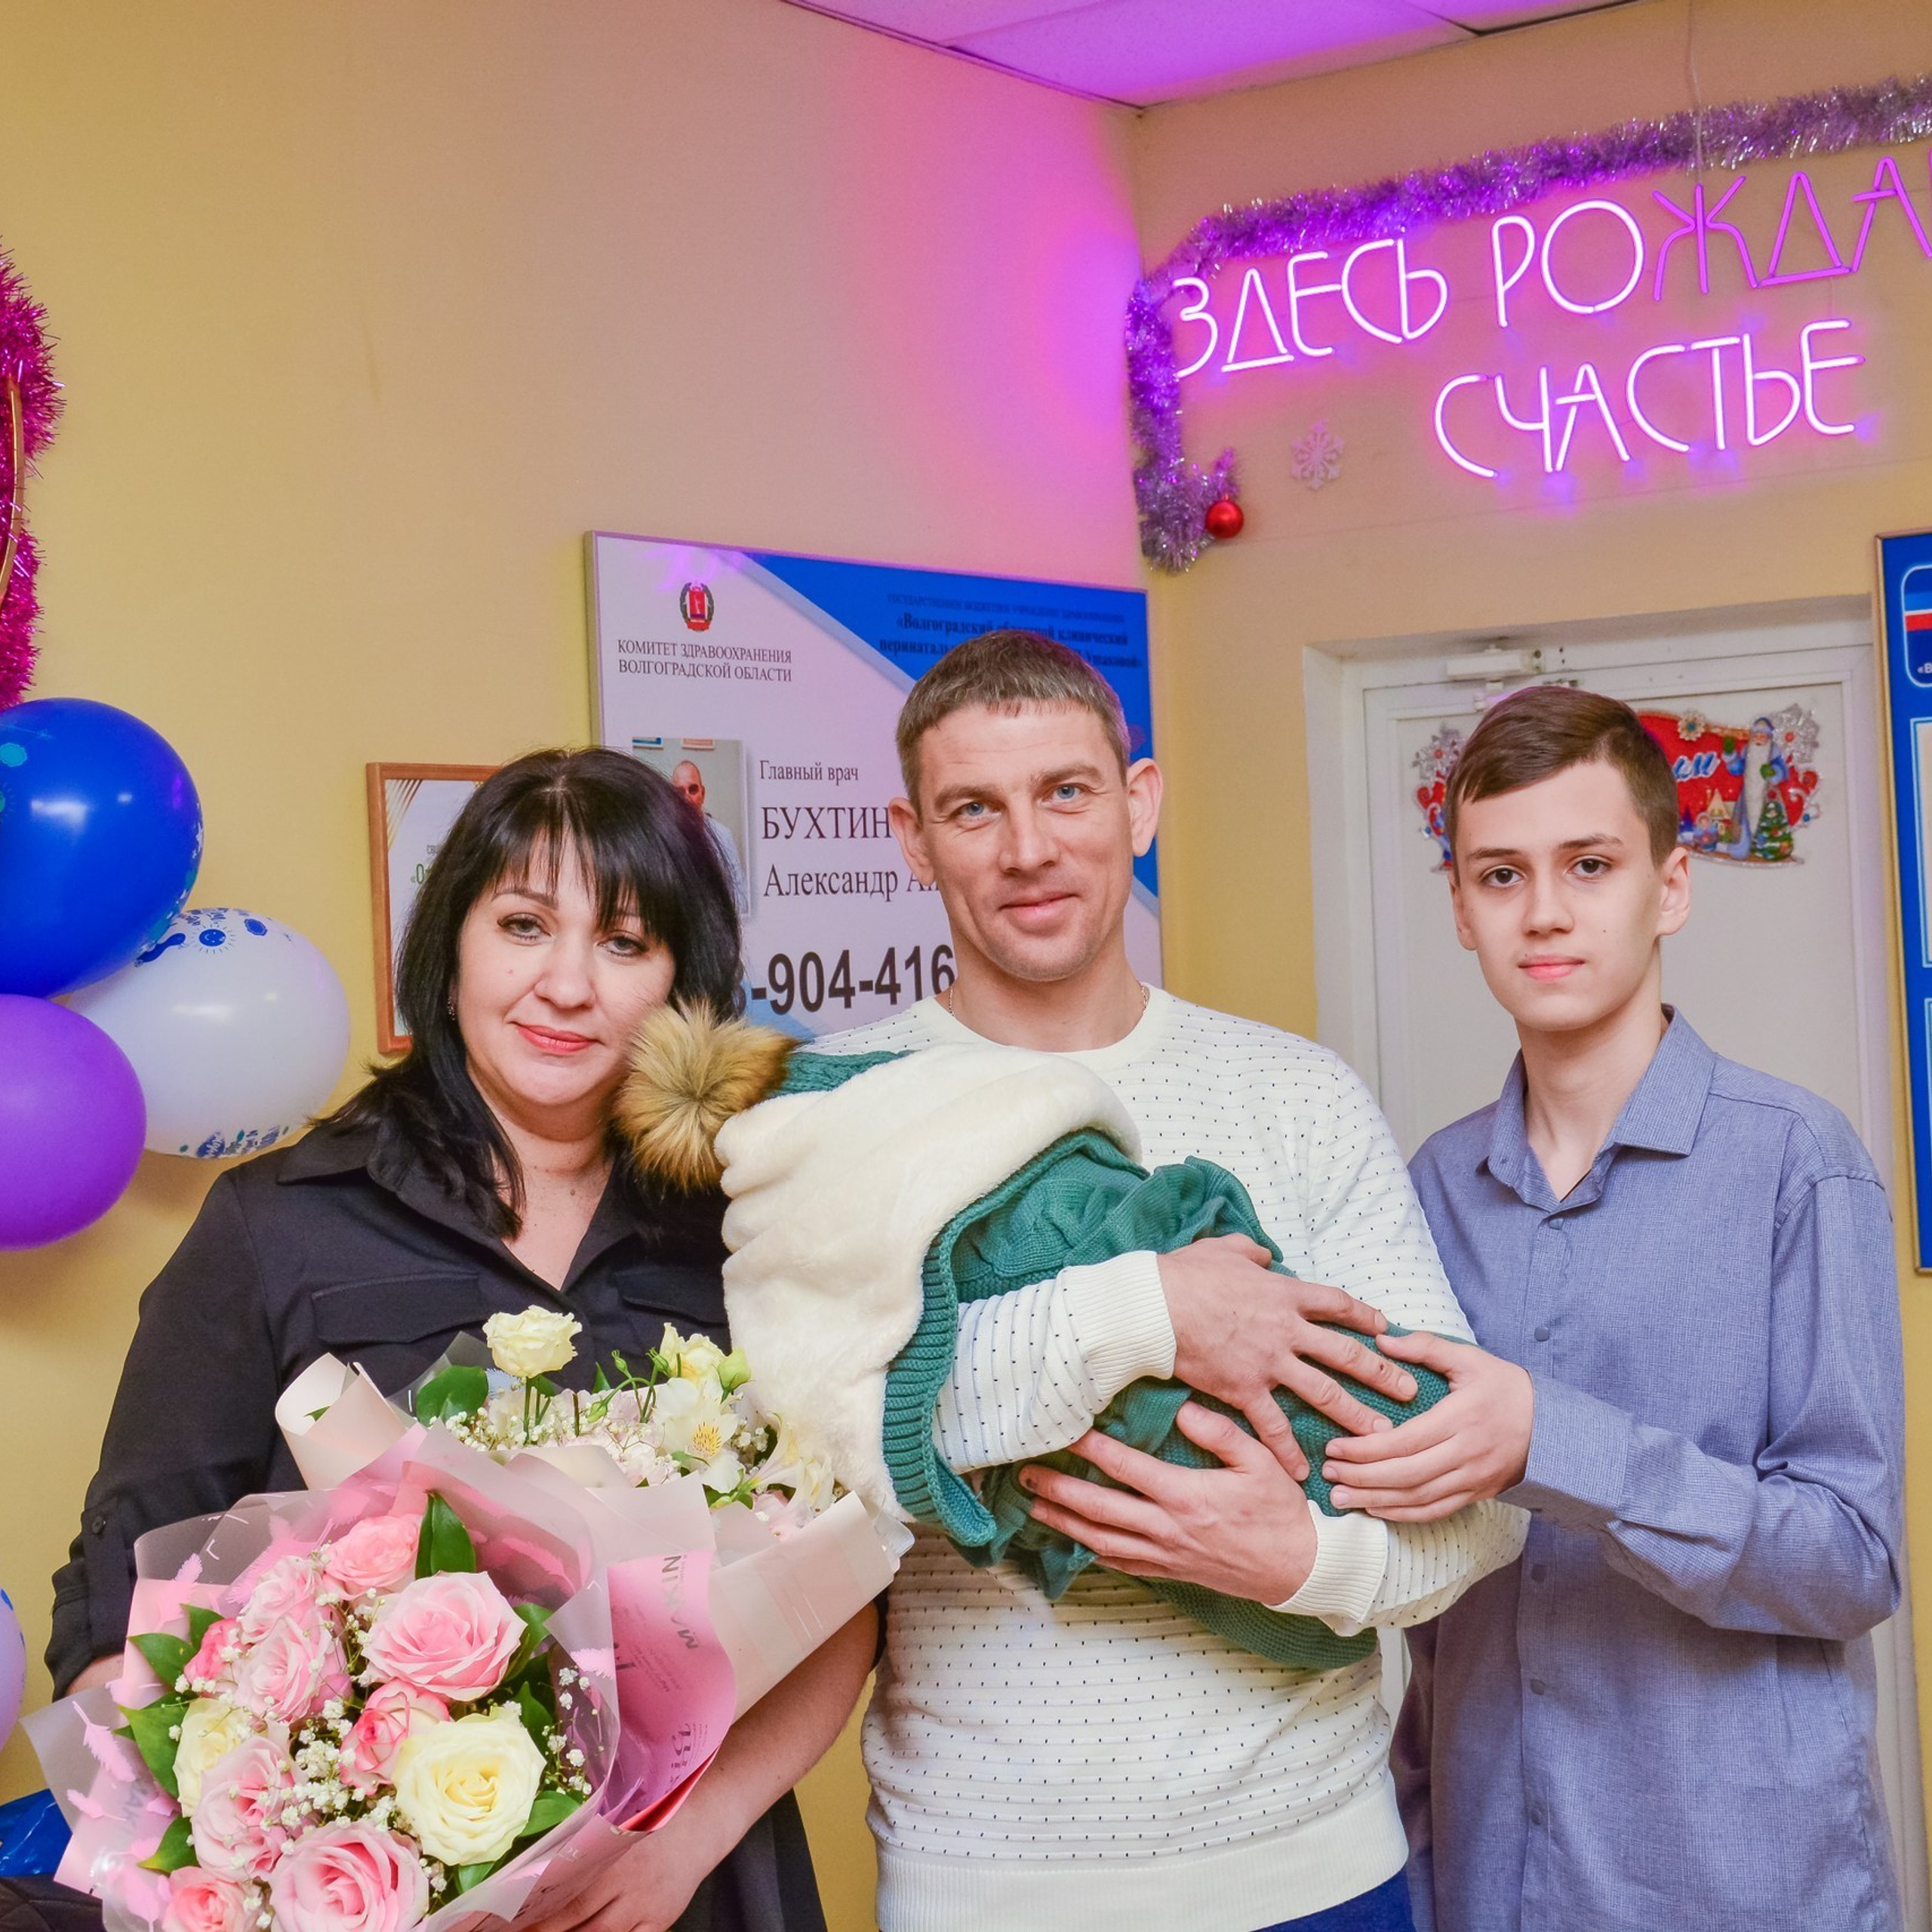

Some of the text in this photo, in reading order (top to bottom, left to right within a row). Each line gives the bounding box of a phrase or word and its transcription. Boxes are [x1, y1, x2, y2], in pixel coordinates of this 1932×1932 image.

[1172, 148, 1932, 380] ЗДЕСЬ РОЖДА
[1433, 318, 1864, 478] СЧАСТЬЕ
[617, 639, 792, 663] КОМИТЕТ ЗДРАВООХРАНЕНИЯ
[618, 659, 792, 682] ВОЛГОГРАДСКОЙ ОБЛАСТИ
[759, 759, 859, 786] Главный врач
[761, 806, 893, 840] БУХТИН
[763, 863, 899, 903] Александр
